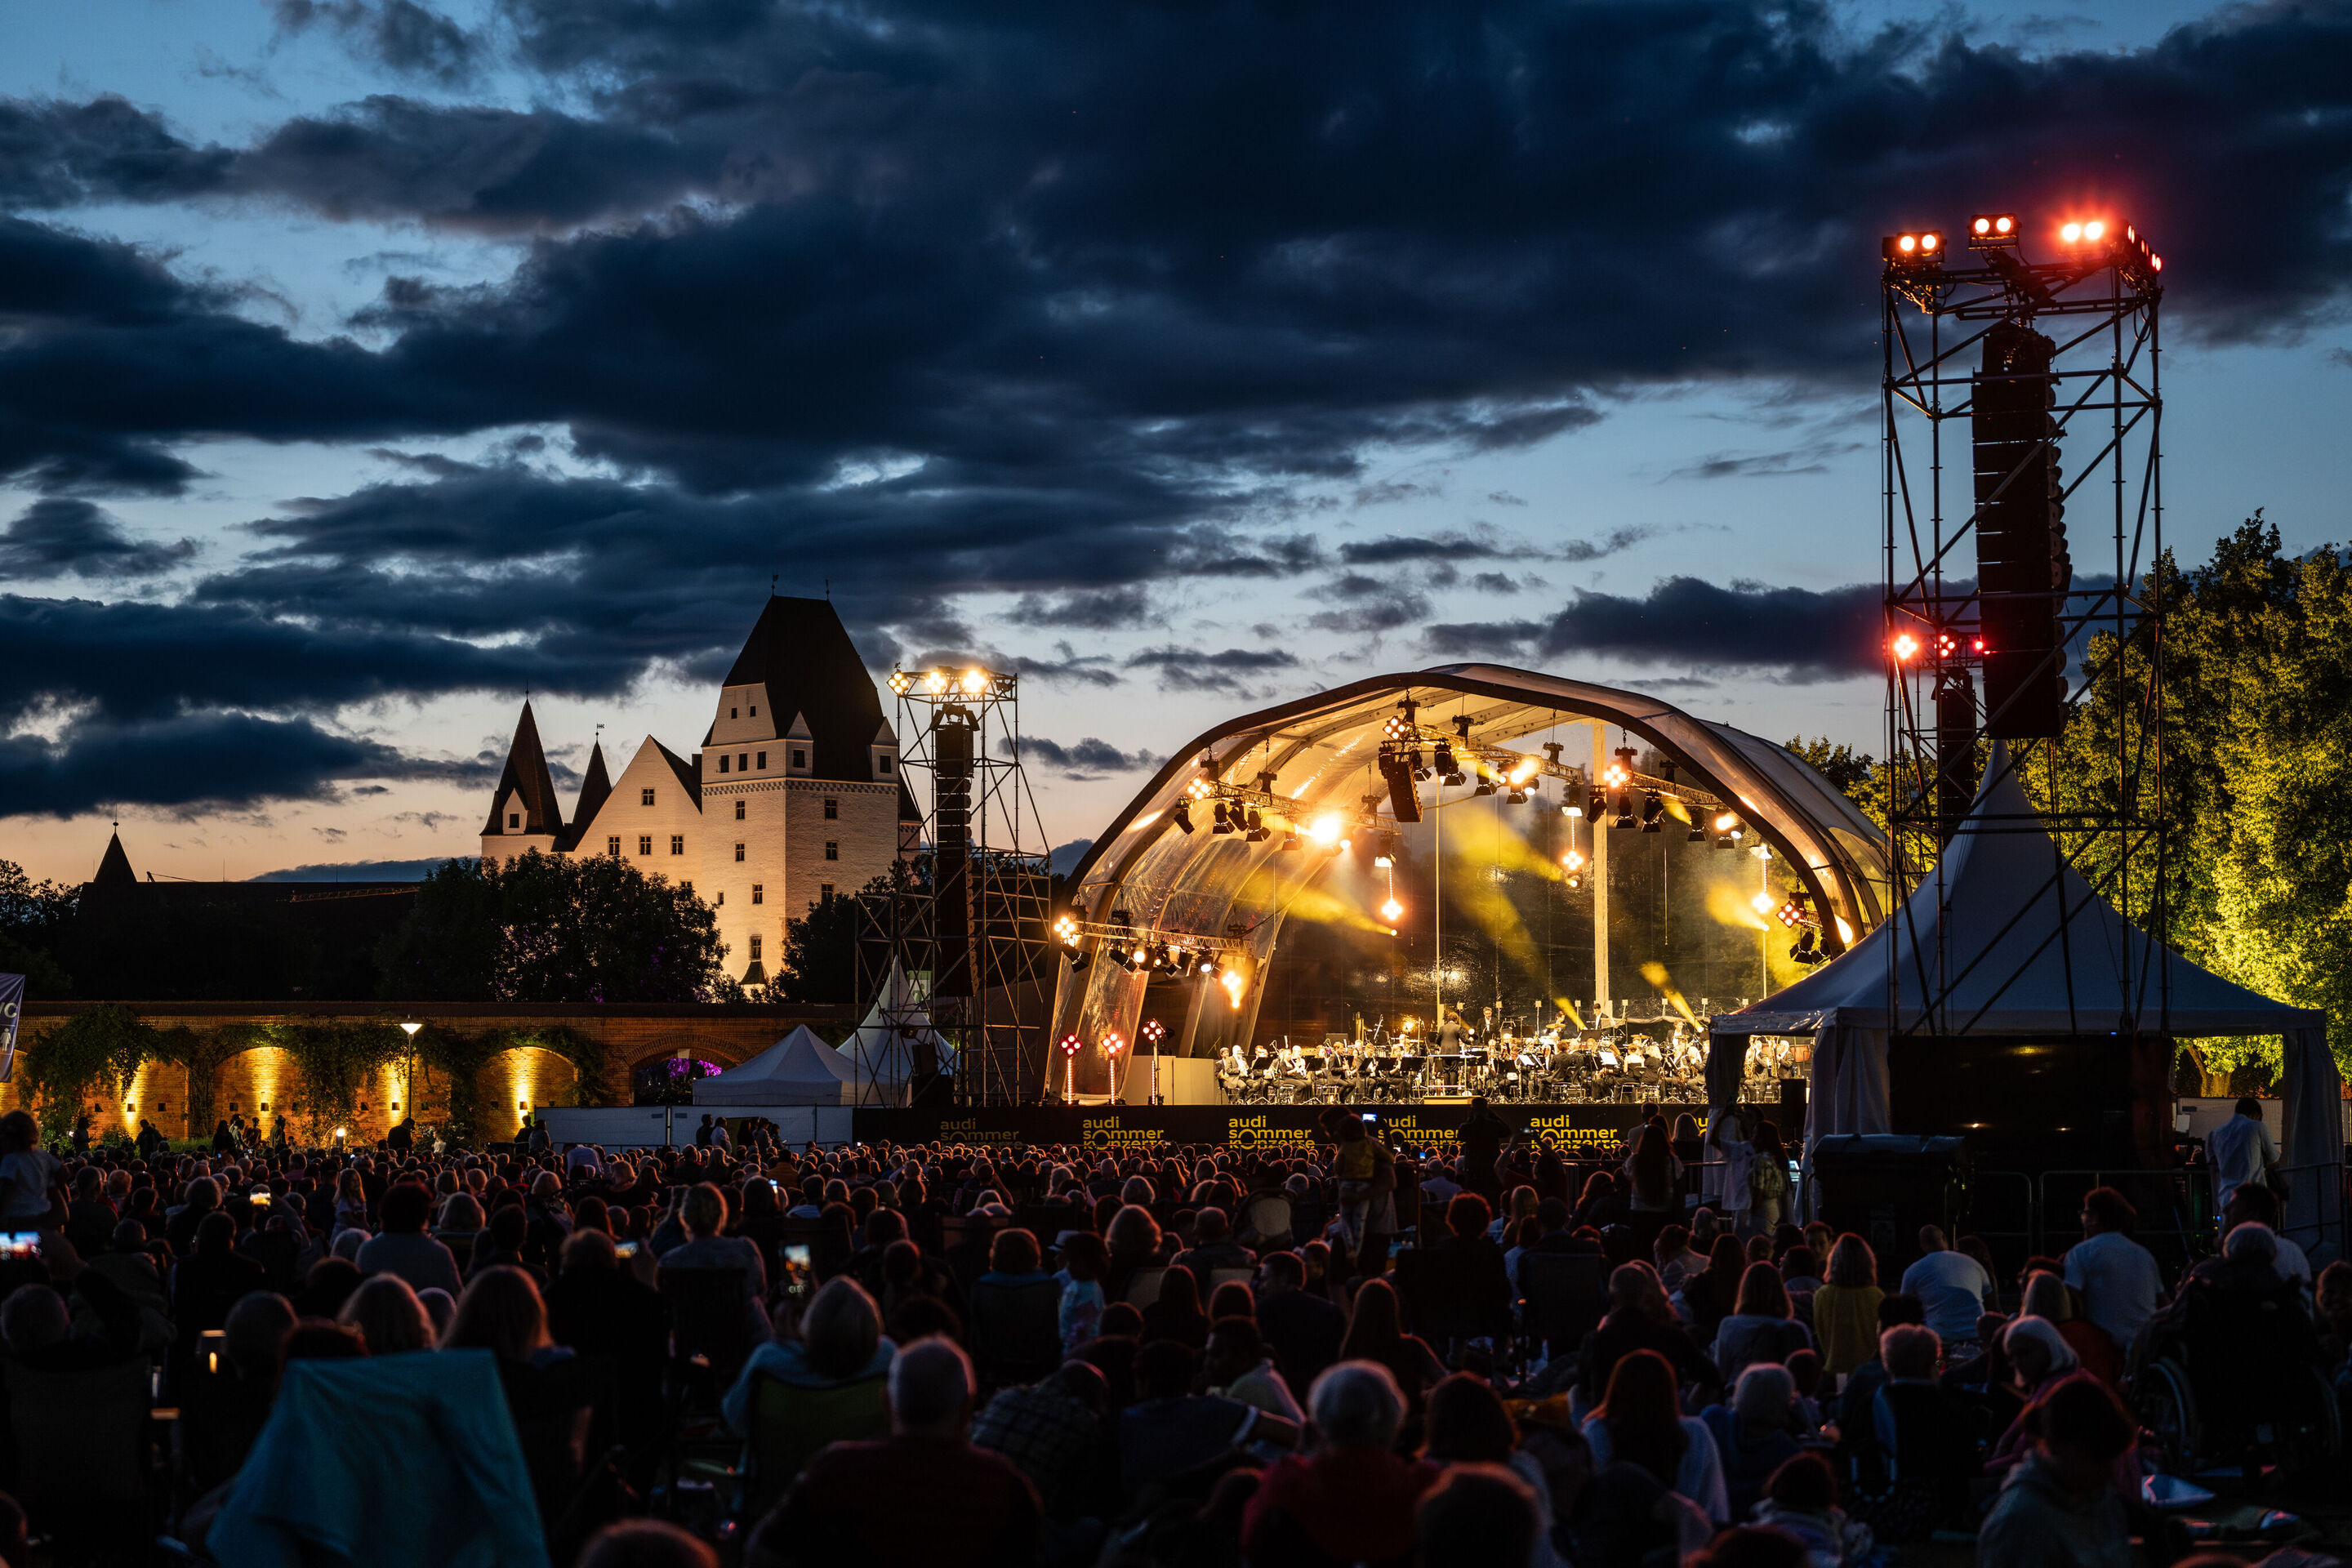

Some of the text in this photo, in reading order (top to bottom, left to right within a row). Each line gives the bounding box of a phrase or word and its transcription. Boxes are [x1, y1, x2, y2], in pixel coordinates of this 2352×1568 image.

[941, 1117, 977, 1130] audi
[1083, 1116, 1120, 1129] audi
[1228, 1115, 1267, 1128] audi
[1530, 1115, 1570, 1128] audi
[1535, 1129, 1618, 1138] ommer
